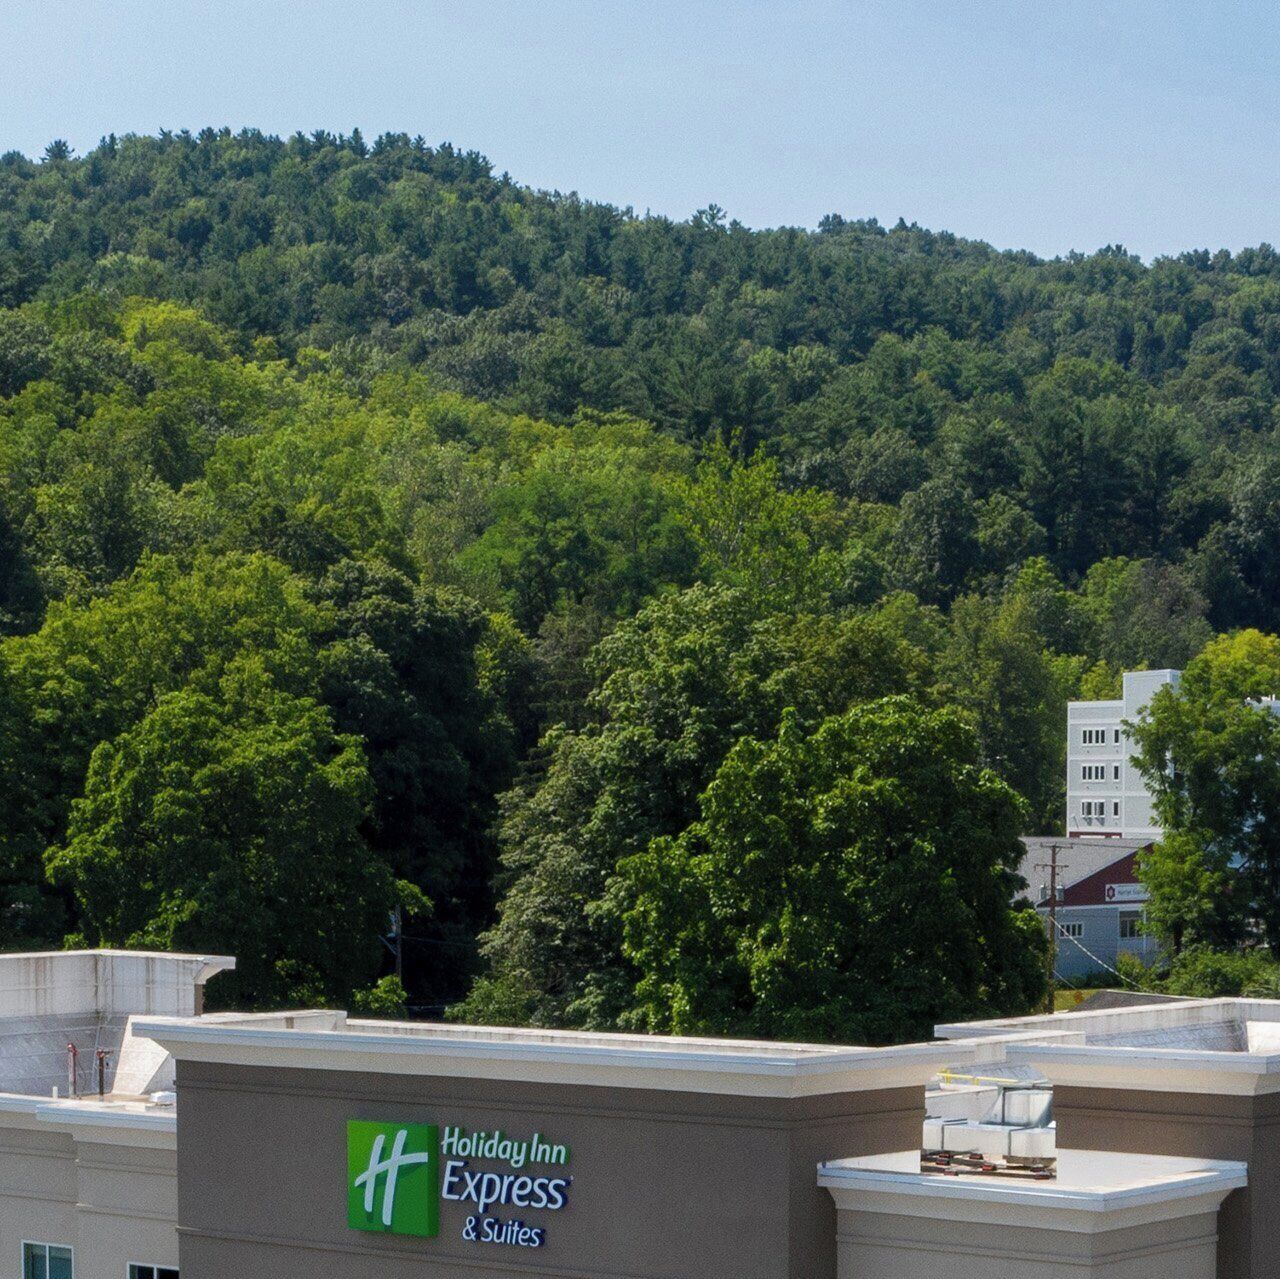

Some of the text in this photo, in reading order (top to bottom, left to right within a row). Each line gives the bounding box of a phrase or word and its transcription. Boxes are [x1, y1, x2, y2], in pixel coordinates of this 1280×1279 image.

[441, 1126, 566, 1168] Holiday Inn
[441, 1161, 568, 1213] Express
[462, 1216, 541, 1247] & Suites
